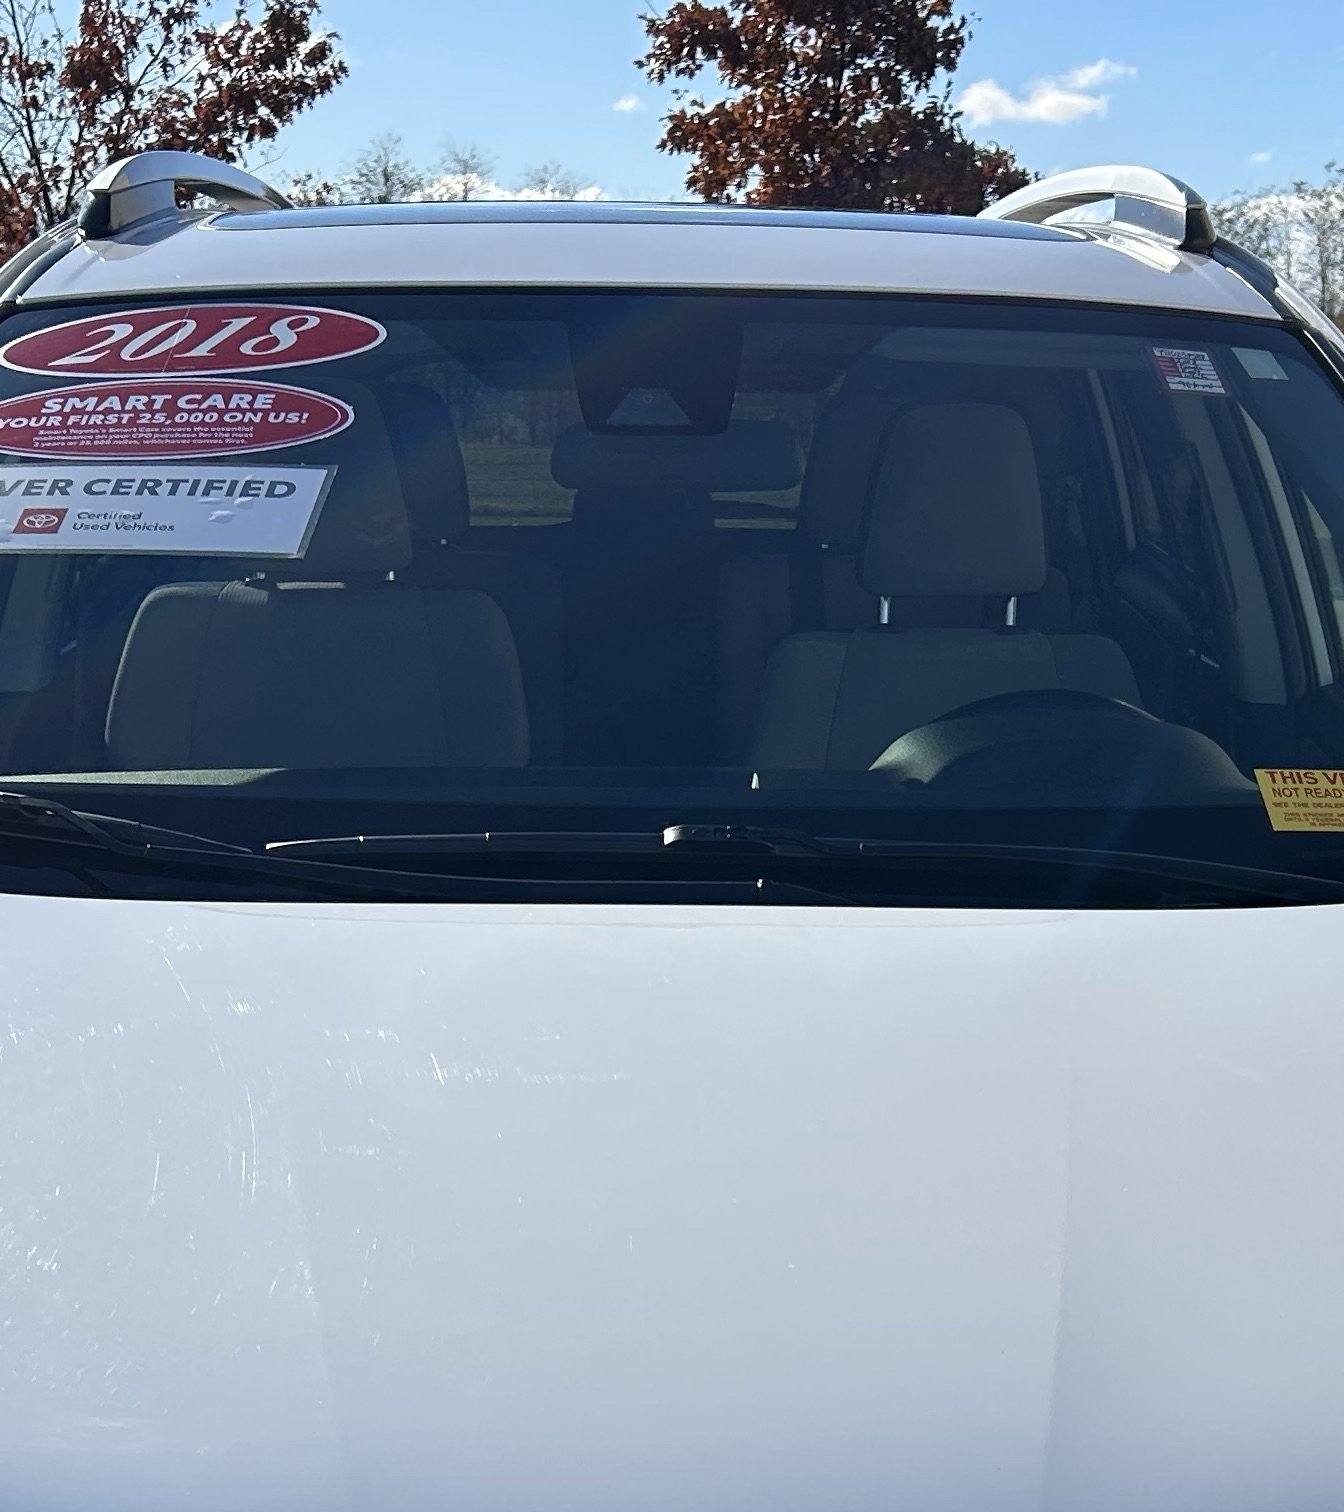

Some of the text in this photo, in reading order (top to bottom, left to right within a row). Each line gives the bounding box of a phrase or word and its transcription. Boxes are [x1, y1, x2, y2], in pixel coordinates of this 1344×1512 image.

[48, 315, 320, 366] 2018
[41, 394, 276, 413] SMART CARE
[67, 413, 137, 426] FIRST
[139, 412, 219, 425] 25,000
[223, 411, 263, 423] ON
[268, 412, 310, 424] US!
[83, 477, 297, 499] CERTIFIED
[77, 511, 143, 521] Certified
[73, 522, 176, 532] Used Vehicles
[1265, 771, 1319, 785] THIS
[1272, 787, 1300, 799] NOT
